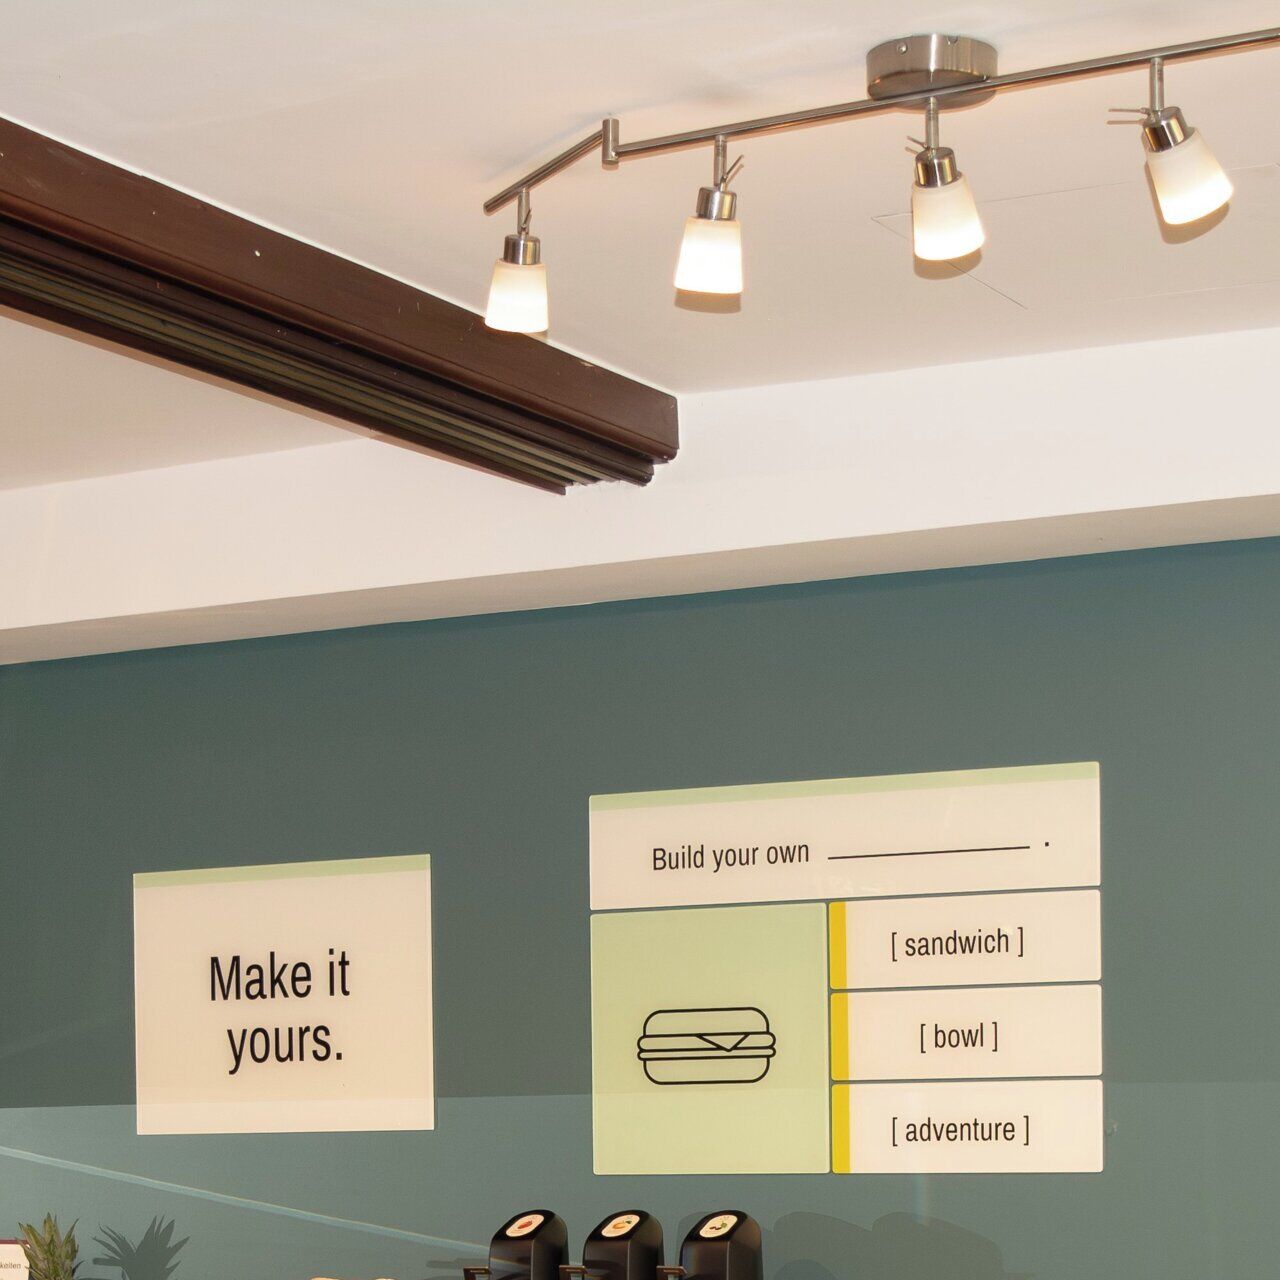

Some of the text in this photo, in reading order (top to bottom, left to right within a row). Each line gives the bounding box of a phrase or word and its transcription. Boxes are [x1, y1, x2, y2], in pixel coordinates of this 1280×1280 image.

[652, 844, 809, 874] Build your own
[905, 927, 1009, 957] sandwich
[210, 948, 350, 1002] Make it
[226, 1024, 343, 1076] yours.
[934, 1022, 984, 1049] bowl
[905, 1116, 1016, 1142] adventure
